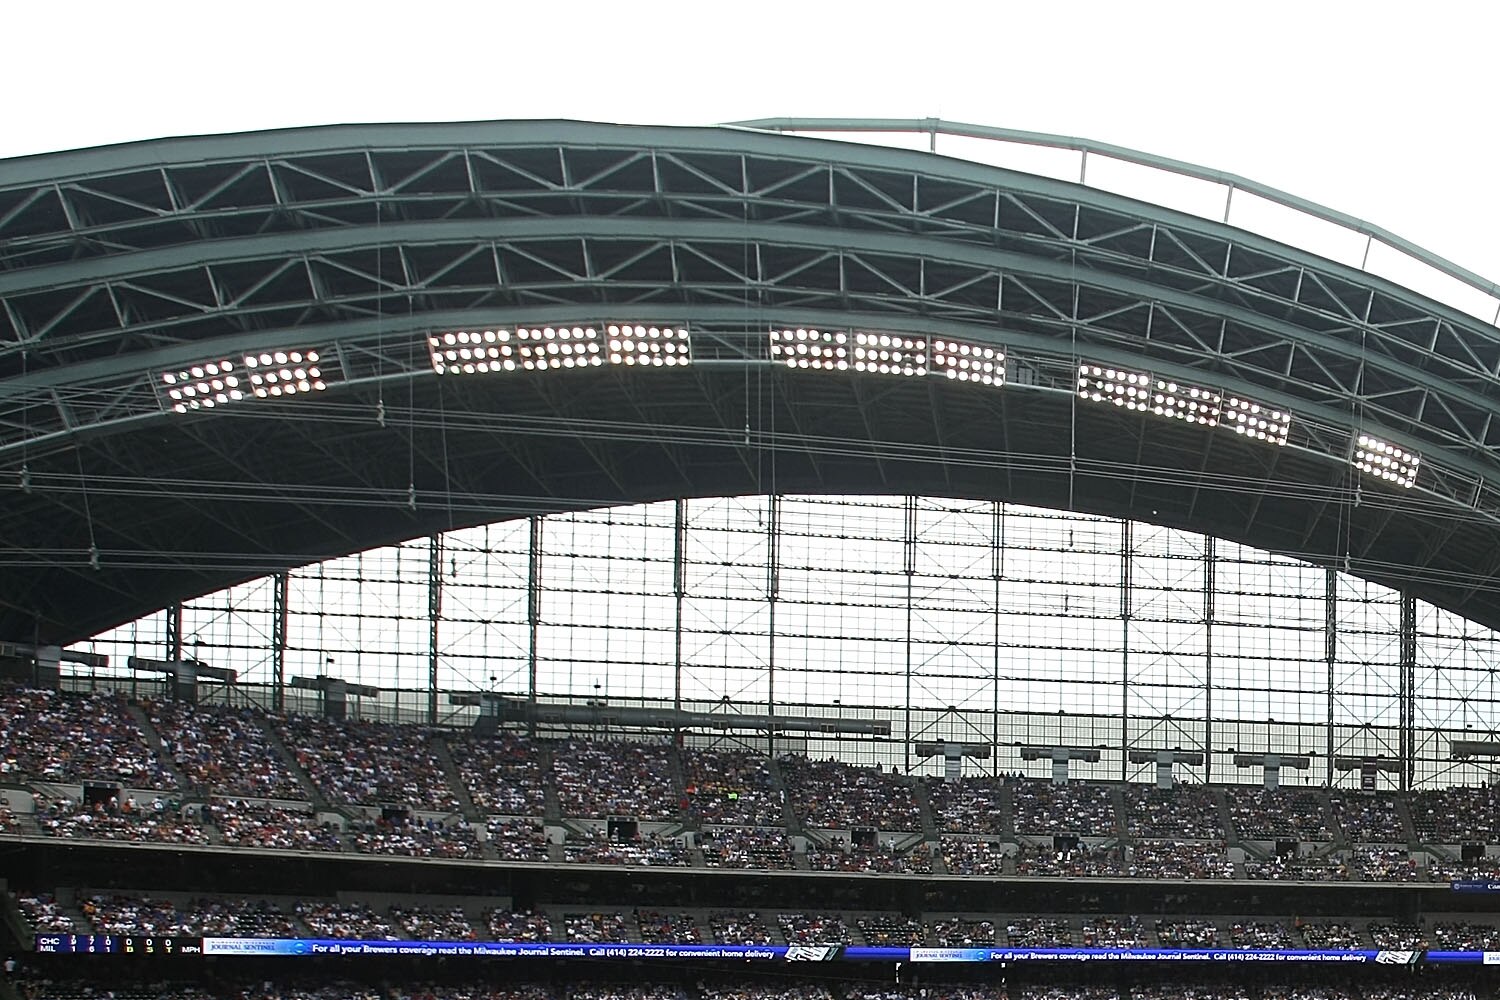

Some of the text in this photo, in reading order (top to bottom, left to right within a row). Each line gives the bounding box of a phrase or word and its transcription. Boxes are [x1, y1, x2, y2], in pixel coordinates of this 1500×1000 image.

[211, 943, 275, 951] JOURNAL SENTINEL
[313, 944, 328, 952] For
[330, 944, 340, 953] all
[341, 946, 361, 955] your
[364, 945, 398, 954] Brewers
[399, 947, 437, 956] coverage
[459, 947, 472, 955] the
[474, 947, 516, 955] Milwaukee
[518, 947, 549, 956] Journal
[550, 948, 585, 956] Sentinel.
[590, 948, 605, 956] Call
[606, 948, 627, 957] (414)
[722, 949, 743, 957] home
[745, 950, 774, 959] delivery
[1323, 953, 1340, 961] home
[1342, 953, 1366, 962] delivery
